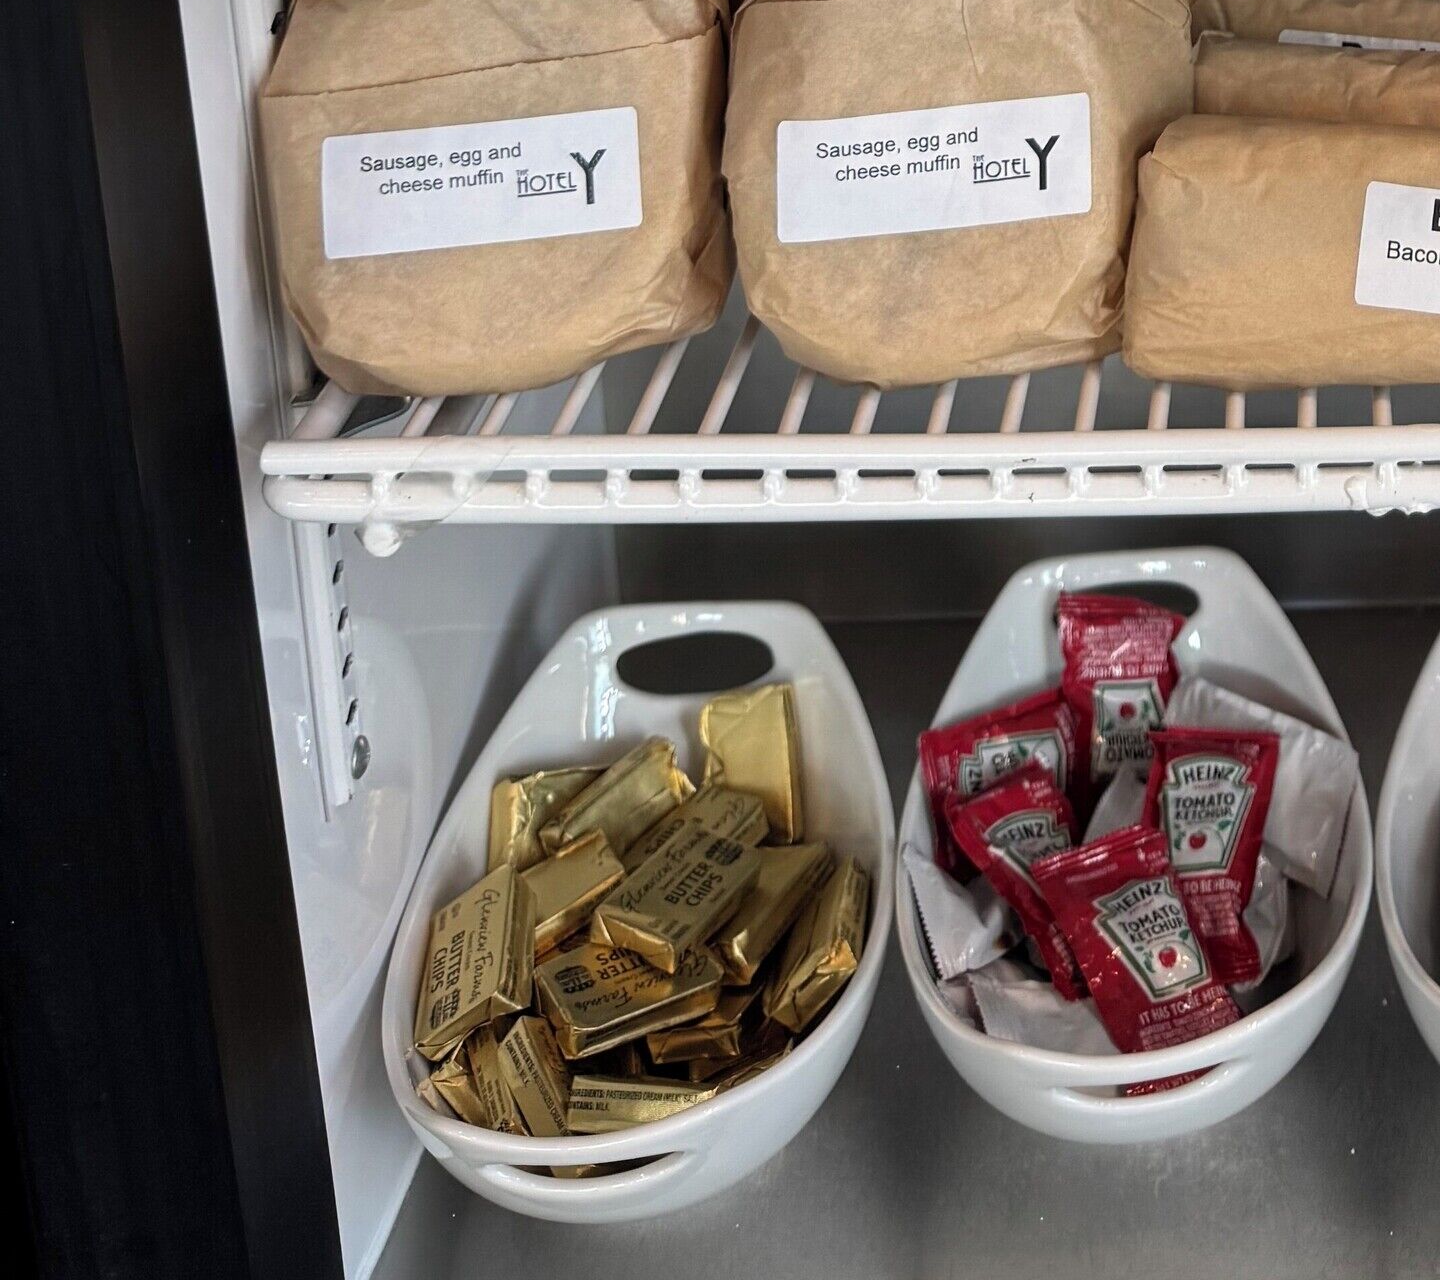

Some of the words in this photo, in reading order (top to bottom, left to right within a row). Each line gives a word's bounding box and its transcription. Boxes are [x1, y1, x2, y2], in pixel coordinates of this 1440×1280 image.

[360, 153, 444, 173] Sausage,
[449, 148, 482, 166] egg
[488, 142, 522, 160] and
[816, 140, 901, 159] Sausage,
[907, 134, 940, 152] egg
[946, 127, 979, 145] and
[517, 171, 577, 194] HOTEL
[570, 149, 607, 204] Y
[835, 163, 901, 182] cheese
[906, 155, 961, 175] muffin
[973, 157, 1031, 181] HOTEL
[1025, 135, 1060, 191] Y
[379, 177, 444, 196] cheese
[449, 168, 504, 189] muffin
[1183, 764, 1234, 785] HEINZ
[1174, 792, 1236, 809] TOMATO
[664, 861, 710, 905] BUTTER
[686, 872, 723, 906] CHIPS
[1114, 878, 1165, 914] HEINZ
[1120, 905, 1181, 933] TOMATO
[1129, 916, 1186, 945] KETCHUP
[431, 948, 447, 993] CHIPS
[446, 930, 465, 991] BUTTER
